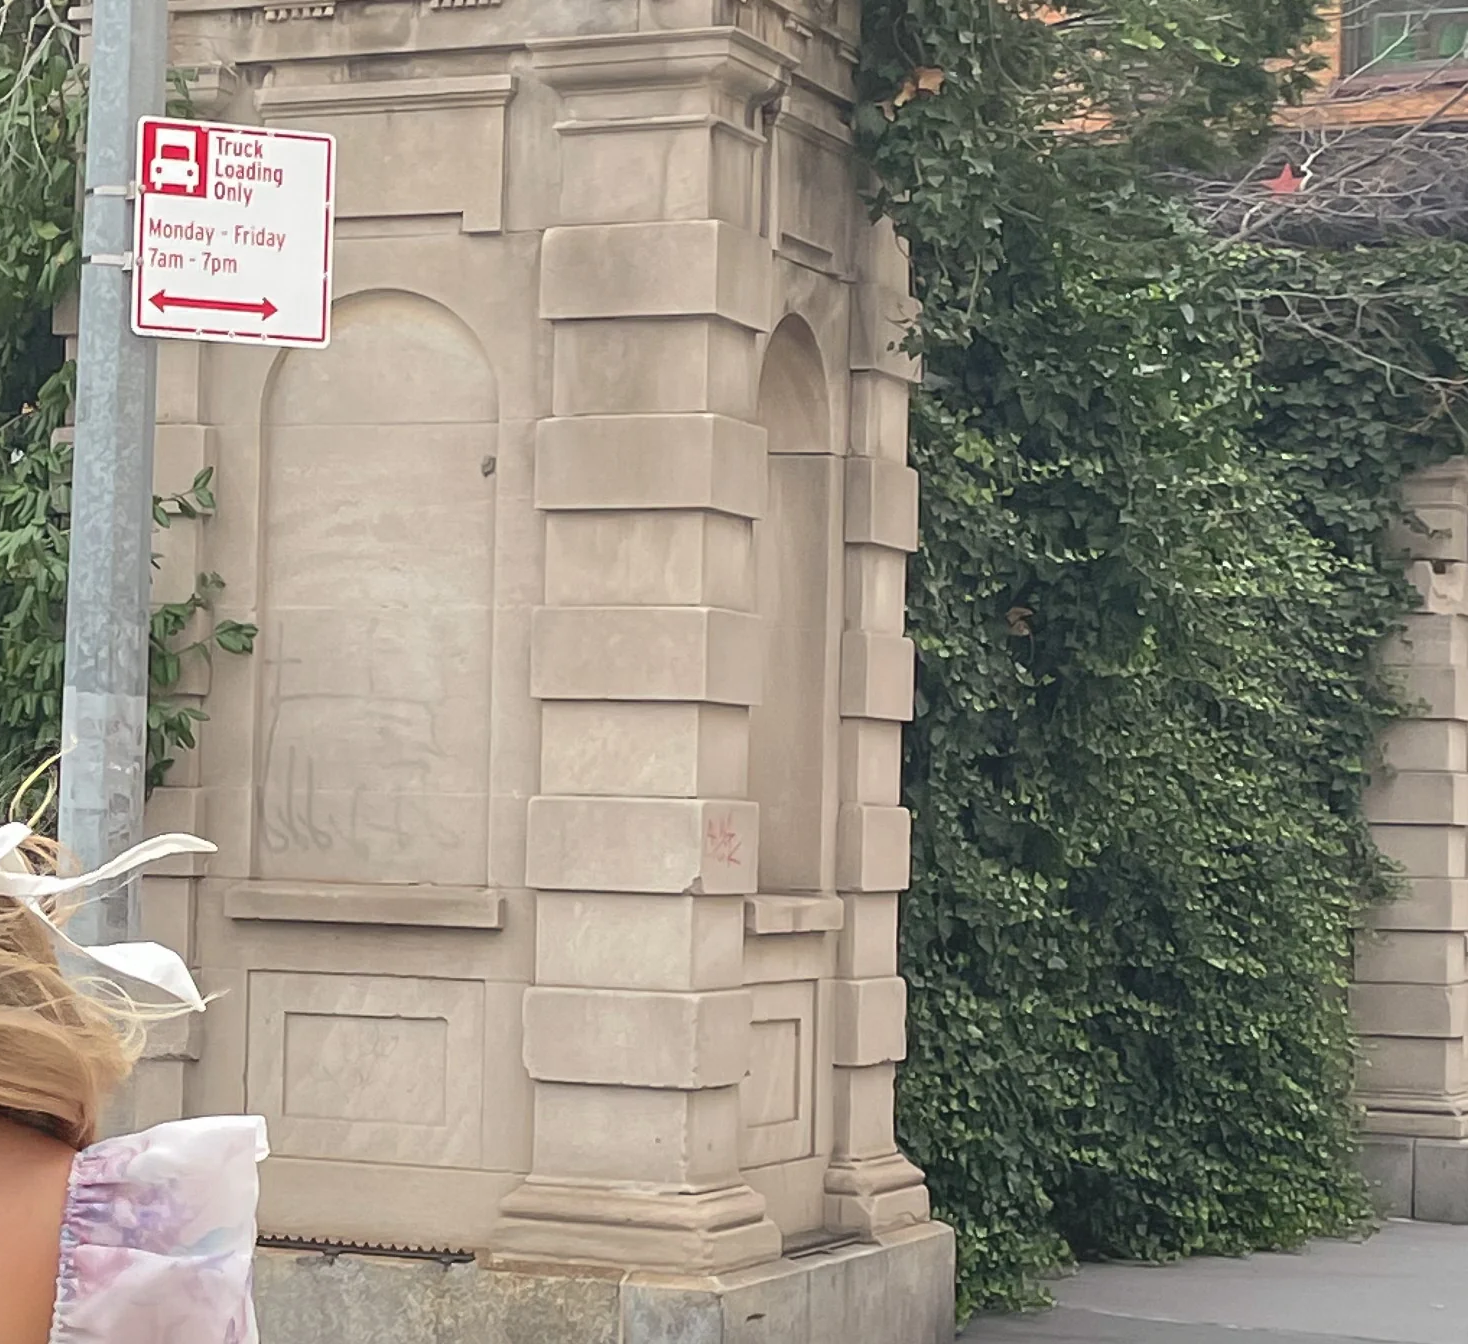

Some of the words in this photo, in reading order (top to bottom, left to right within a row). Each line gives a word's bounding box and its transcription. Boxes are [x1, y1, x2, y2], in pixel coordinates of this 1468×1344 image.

[216, 137, 263, 158] Truck
[215, 159, 283, 188] Loading
[214, 182, 253, 207] Only
[149, 218, 215, 244] Monday
[234, 225, 286, 252] Friday
[148, 248, 183, 269] 7am
[202, 252, 237, 275] 7pm
